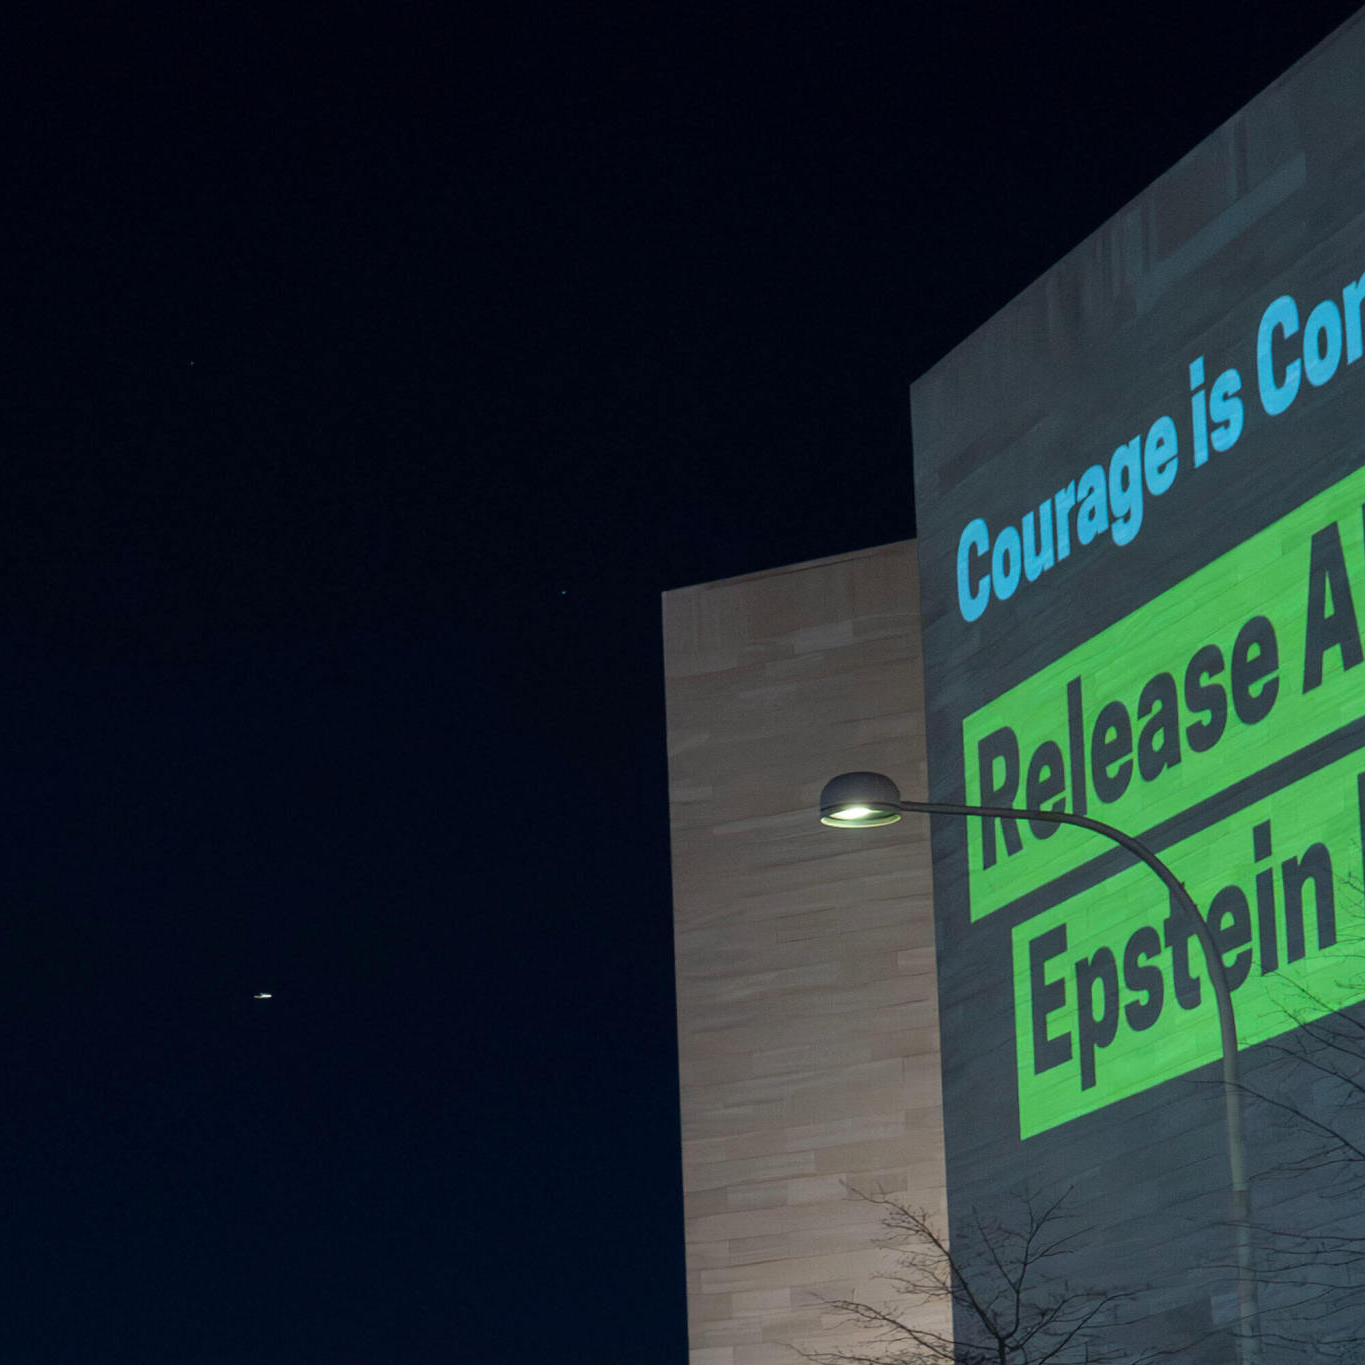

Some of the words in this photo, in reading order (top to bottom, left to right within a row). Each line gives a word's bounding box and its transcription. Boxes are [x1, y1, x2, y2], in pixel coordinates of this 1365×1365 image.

[956, 416, 1180, 623] Courage
[1189, 355, 1245, 469] is
[976, 614, 1280, 871] Release
[1028, 819, 1338, 1091] Epstein
